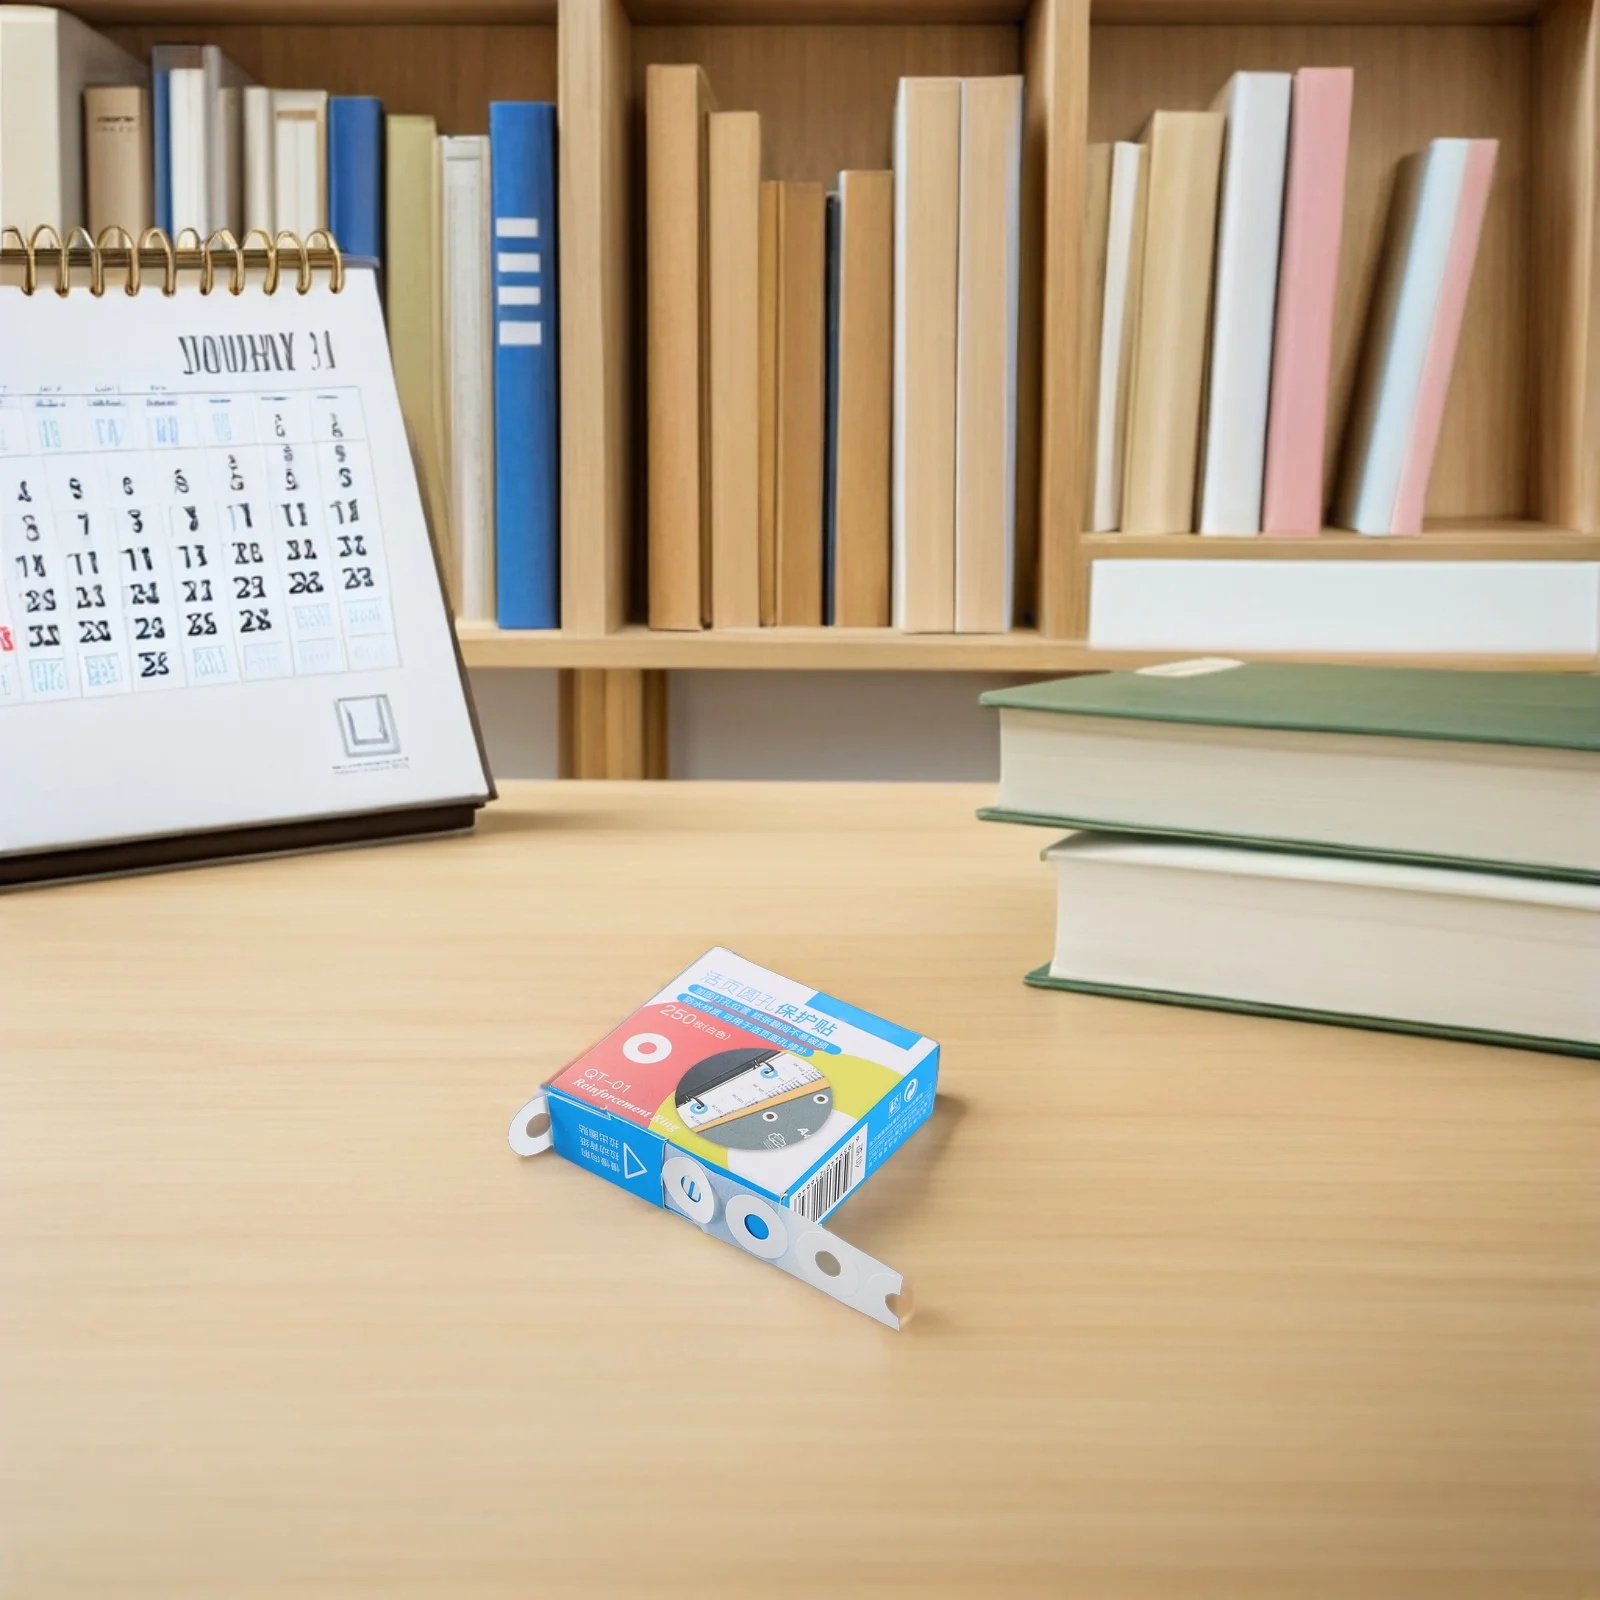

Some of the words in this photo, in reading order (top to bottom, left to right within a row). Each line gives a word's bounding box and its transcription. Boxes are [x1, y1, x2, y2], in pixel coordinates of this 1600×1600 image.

[683, 996, 722, 1017] 防水材质
[700, 969, 838, 1037] 活页圆孔保护贴
[584, 1068, 632, 1093] QT-01
[572, 1078, 652, 1118] Reinforcement
[650, 1113, 681, 1133] Ring
